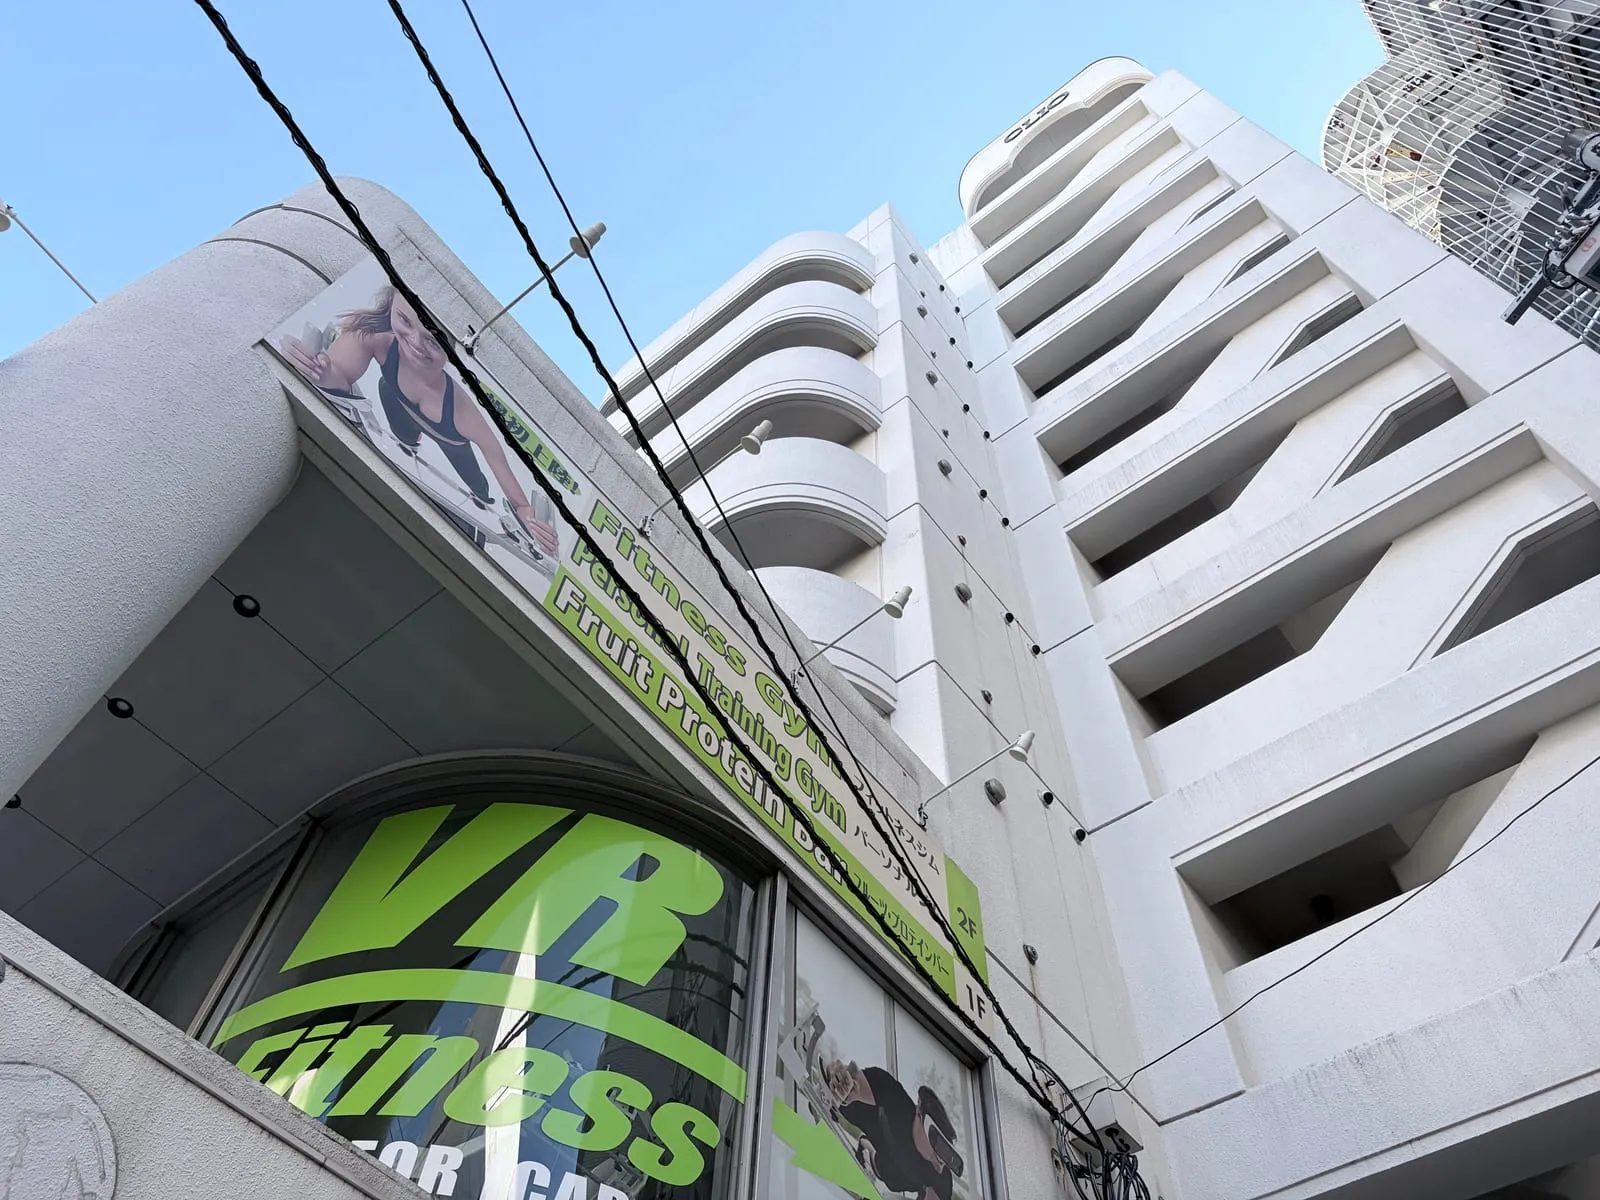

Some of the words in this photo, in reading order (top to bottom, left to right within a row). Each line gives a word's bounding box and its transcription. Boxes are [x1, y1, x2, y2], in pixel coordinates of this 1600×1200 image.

[589, 499, 747, 677] Fitness
[554, 575, 654, 694] Fruit
[656, 673, 787, 829] Protein
[697, 652, 792, 781] Training
[795, 757, 847, 833] Gym
[280, 802, 725, 987] VR
[957, 907, 977, 939] 2F
[966, 983, 986, 1019] 1F
